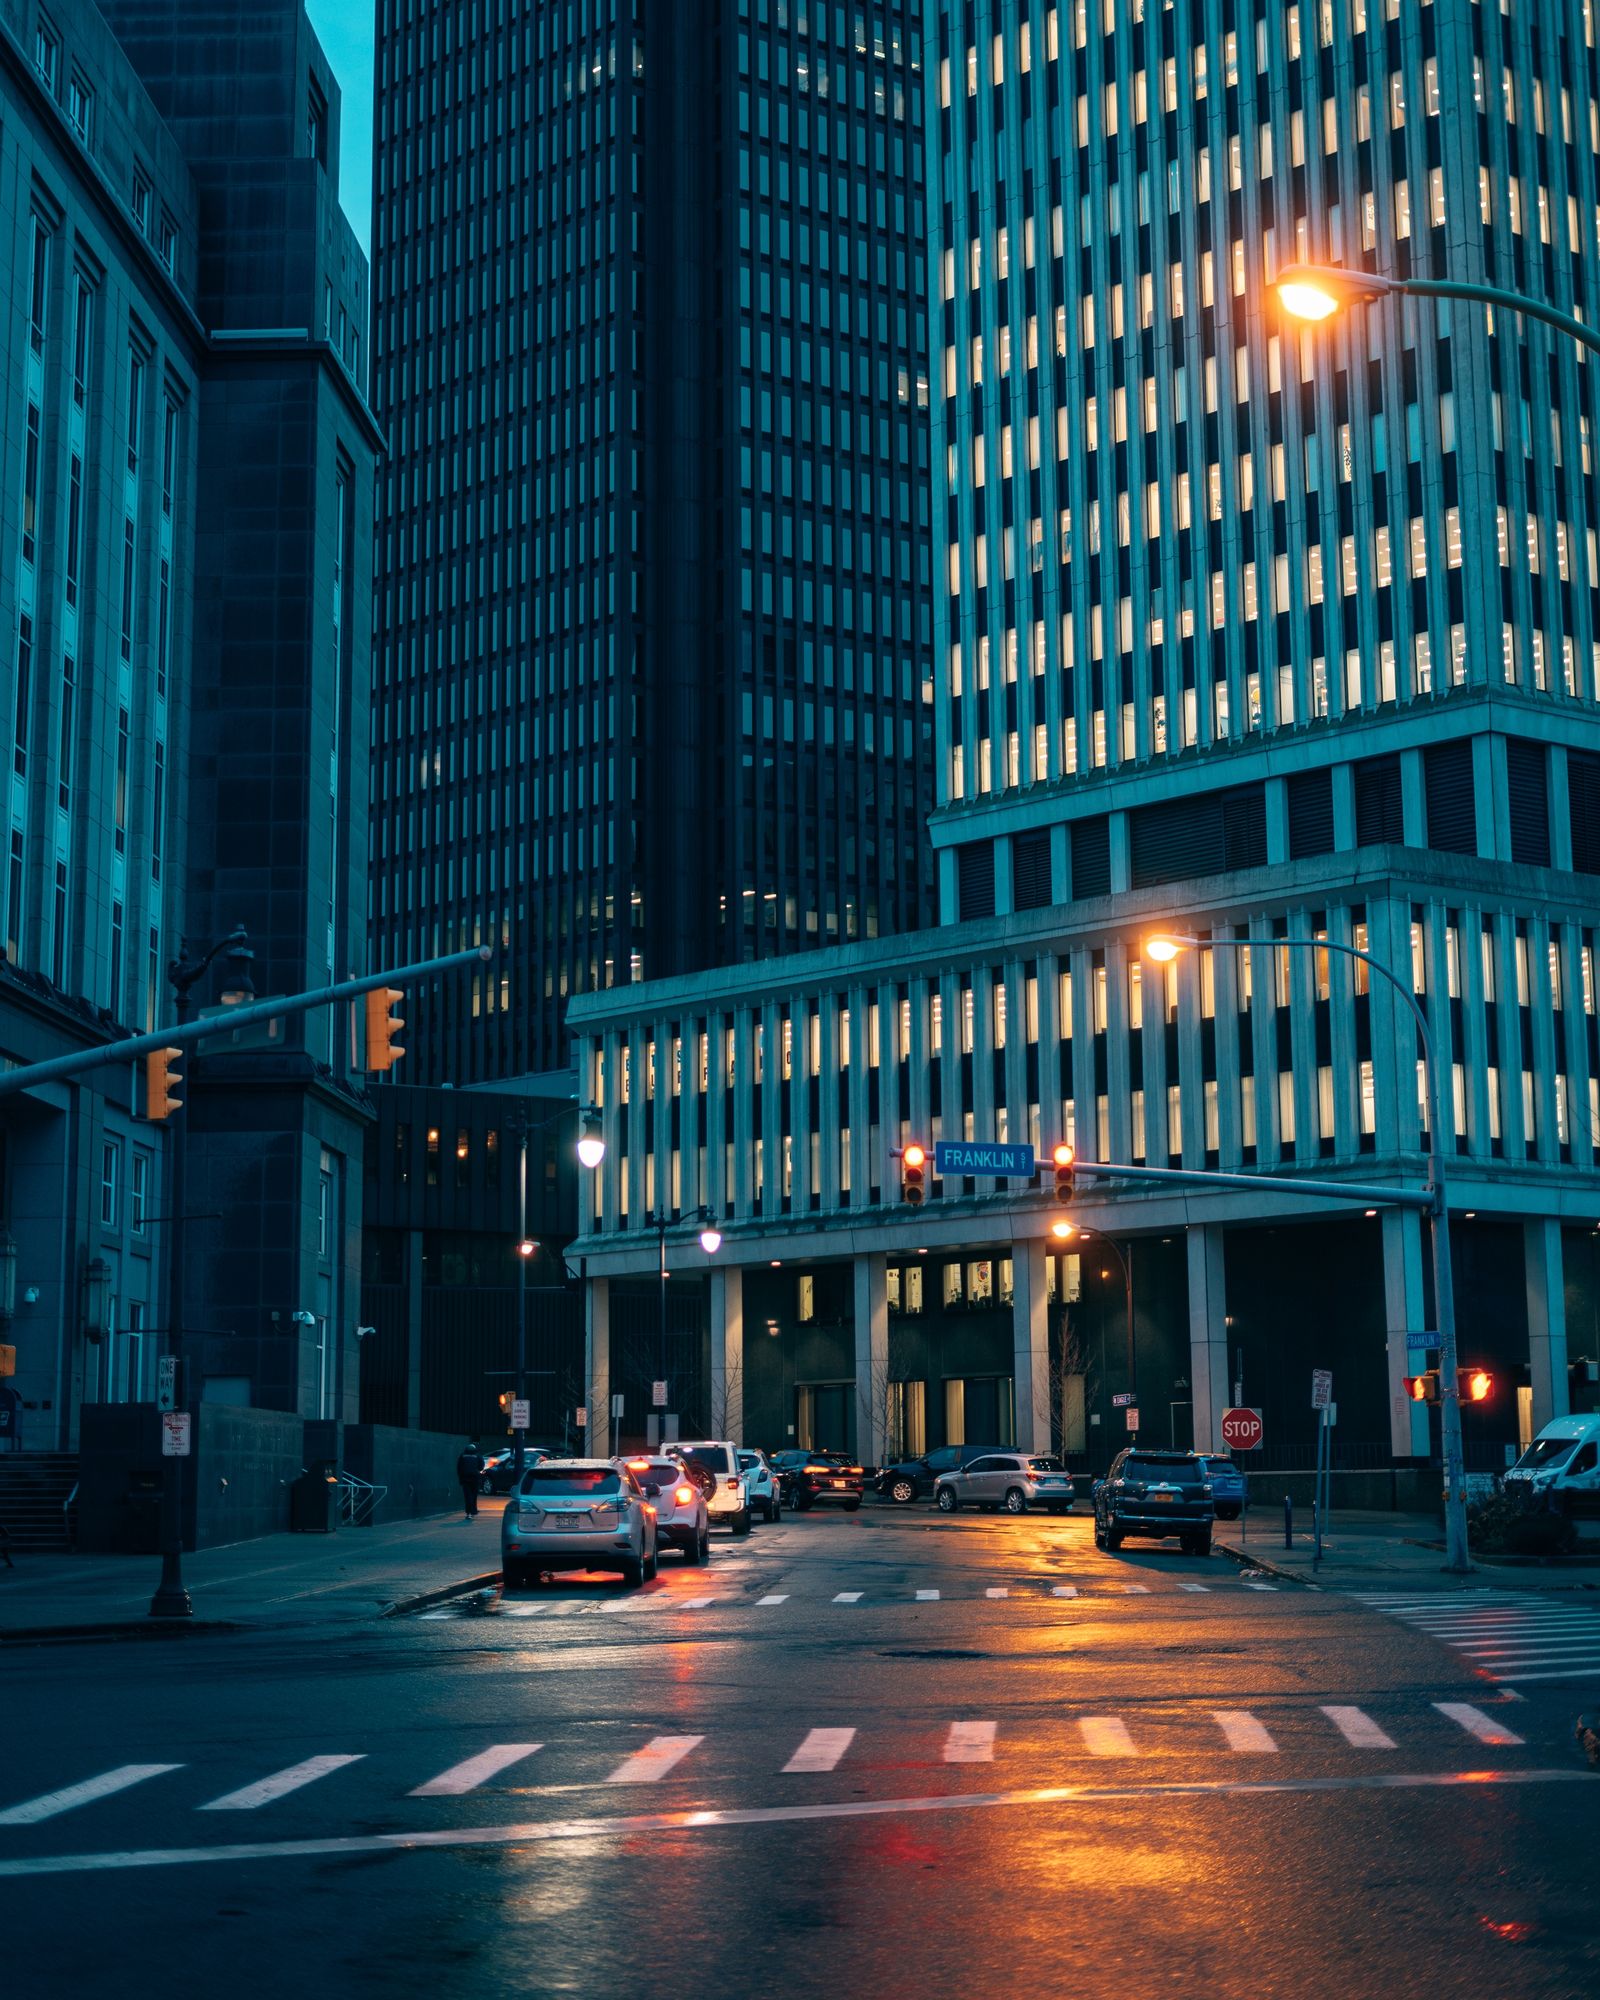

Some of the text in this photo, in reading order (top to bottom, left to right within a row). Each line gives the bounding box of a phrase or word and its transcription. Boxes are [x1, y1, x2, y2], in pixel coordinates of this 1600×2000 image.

[944, 1149, 1026, 1169] FRANKLIN ST
[1407, 1334, 1435, 1346] FRANKLIN
[160, 1360, 174, 1375] ONE
[160, 1376, 174, 1390] WAY
[1224, 1421, 1260, 1437] STOP
